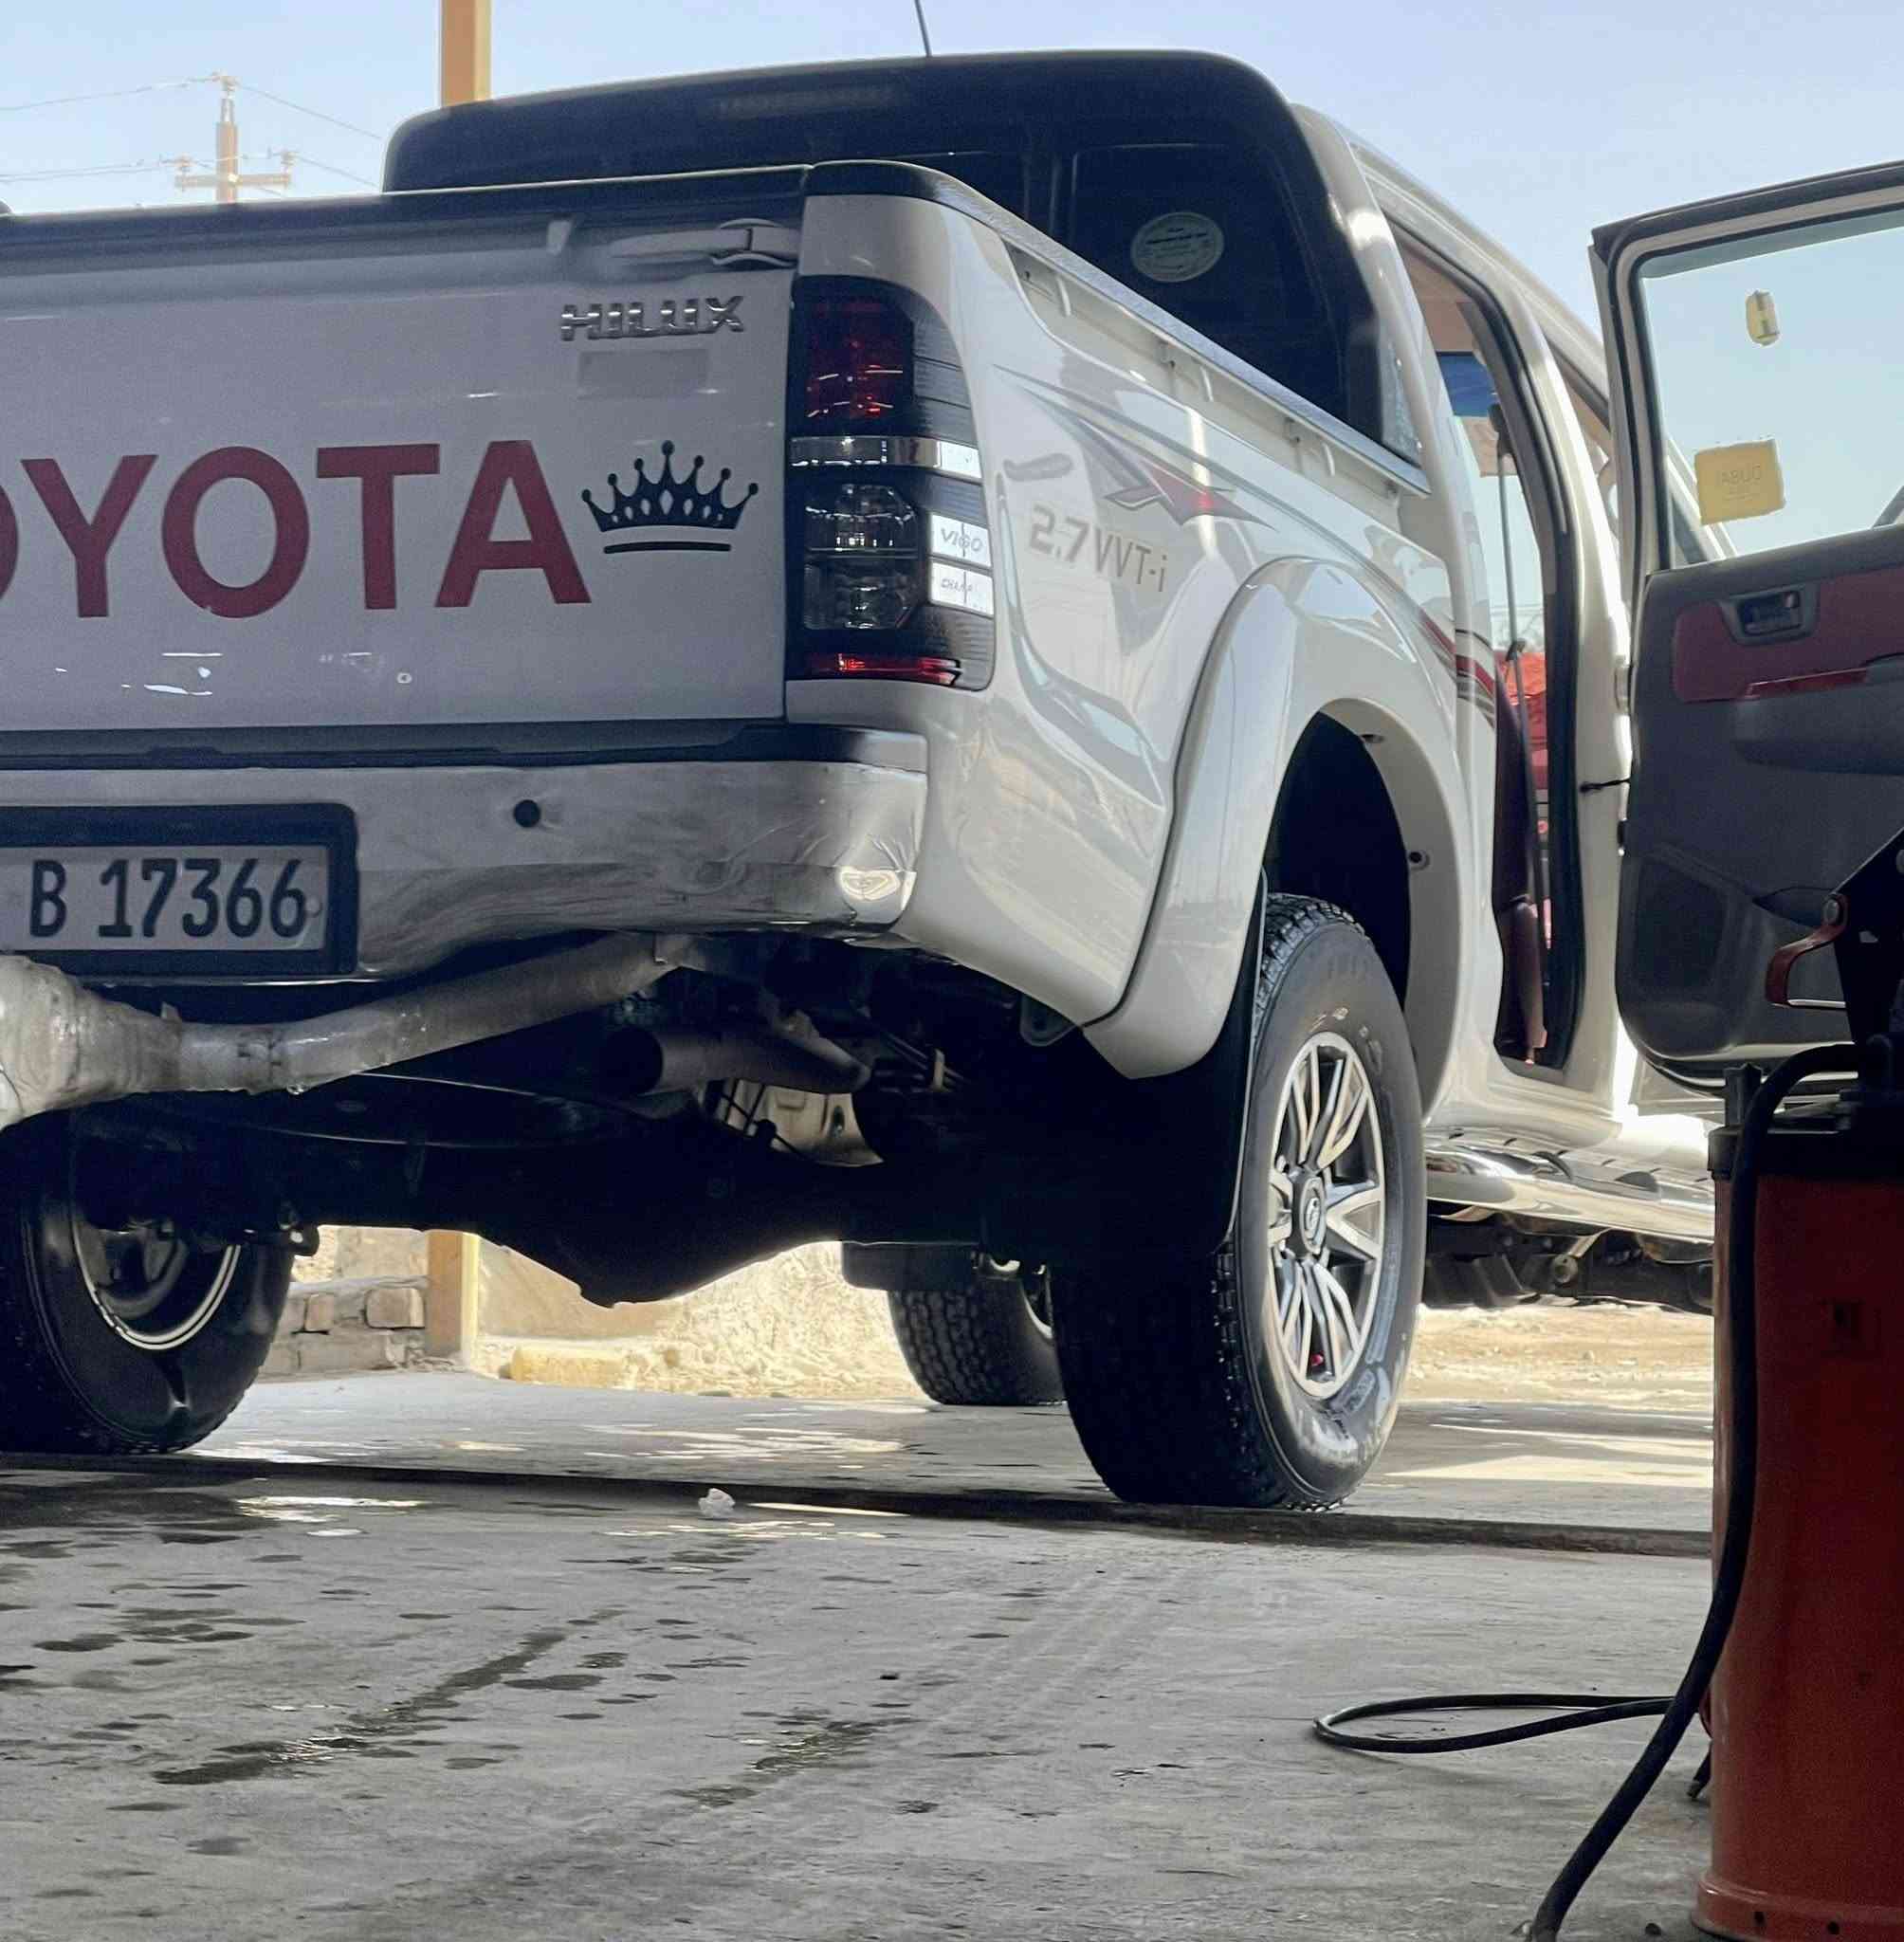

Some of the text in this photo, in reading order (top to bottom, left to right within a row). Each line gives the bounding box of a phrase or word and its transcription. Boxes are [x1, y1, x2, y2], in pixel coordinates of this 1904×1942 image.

[560, 296, 744, 341] HILUX
[0, 439, 593, 619] YOTA
[941, 527, 983, 552] VIGO
[29, 857, 307, 938] B 17366
